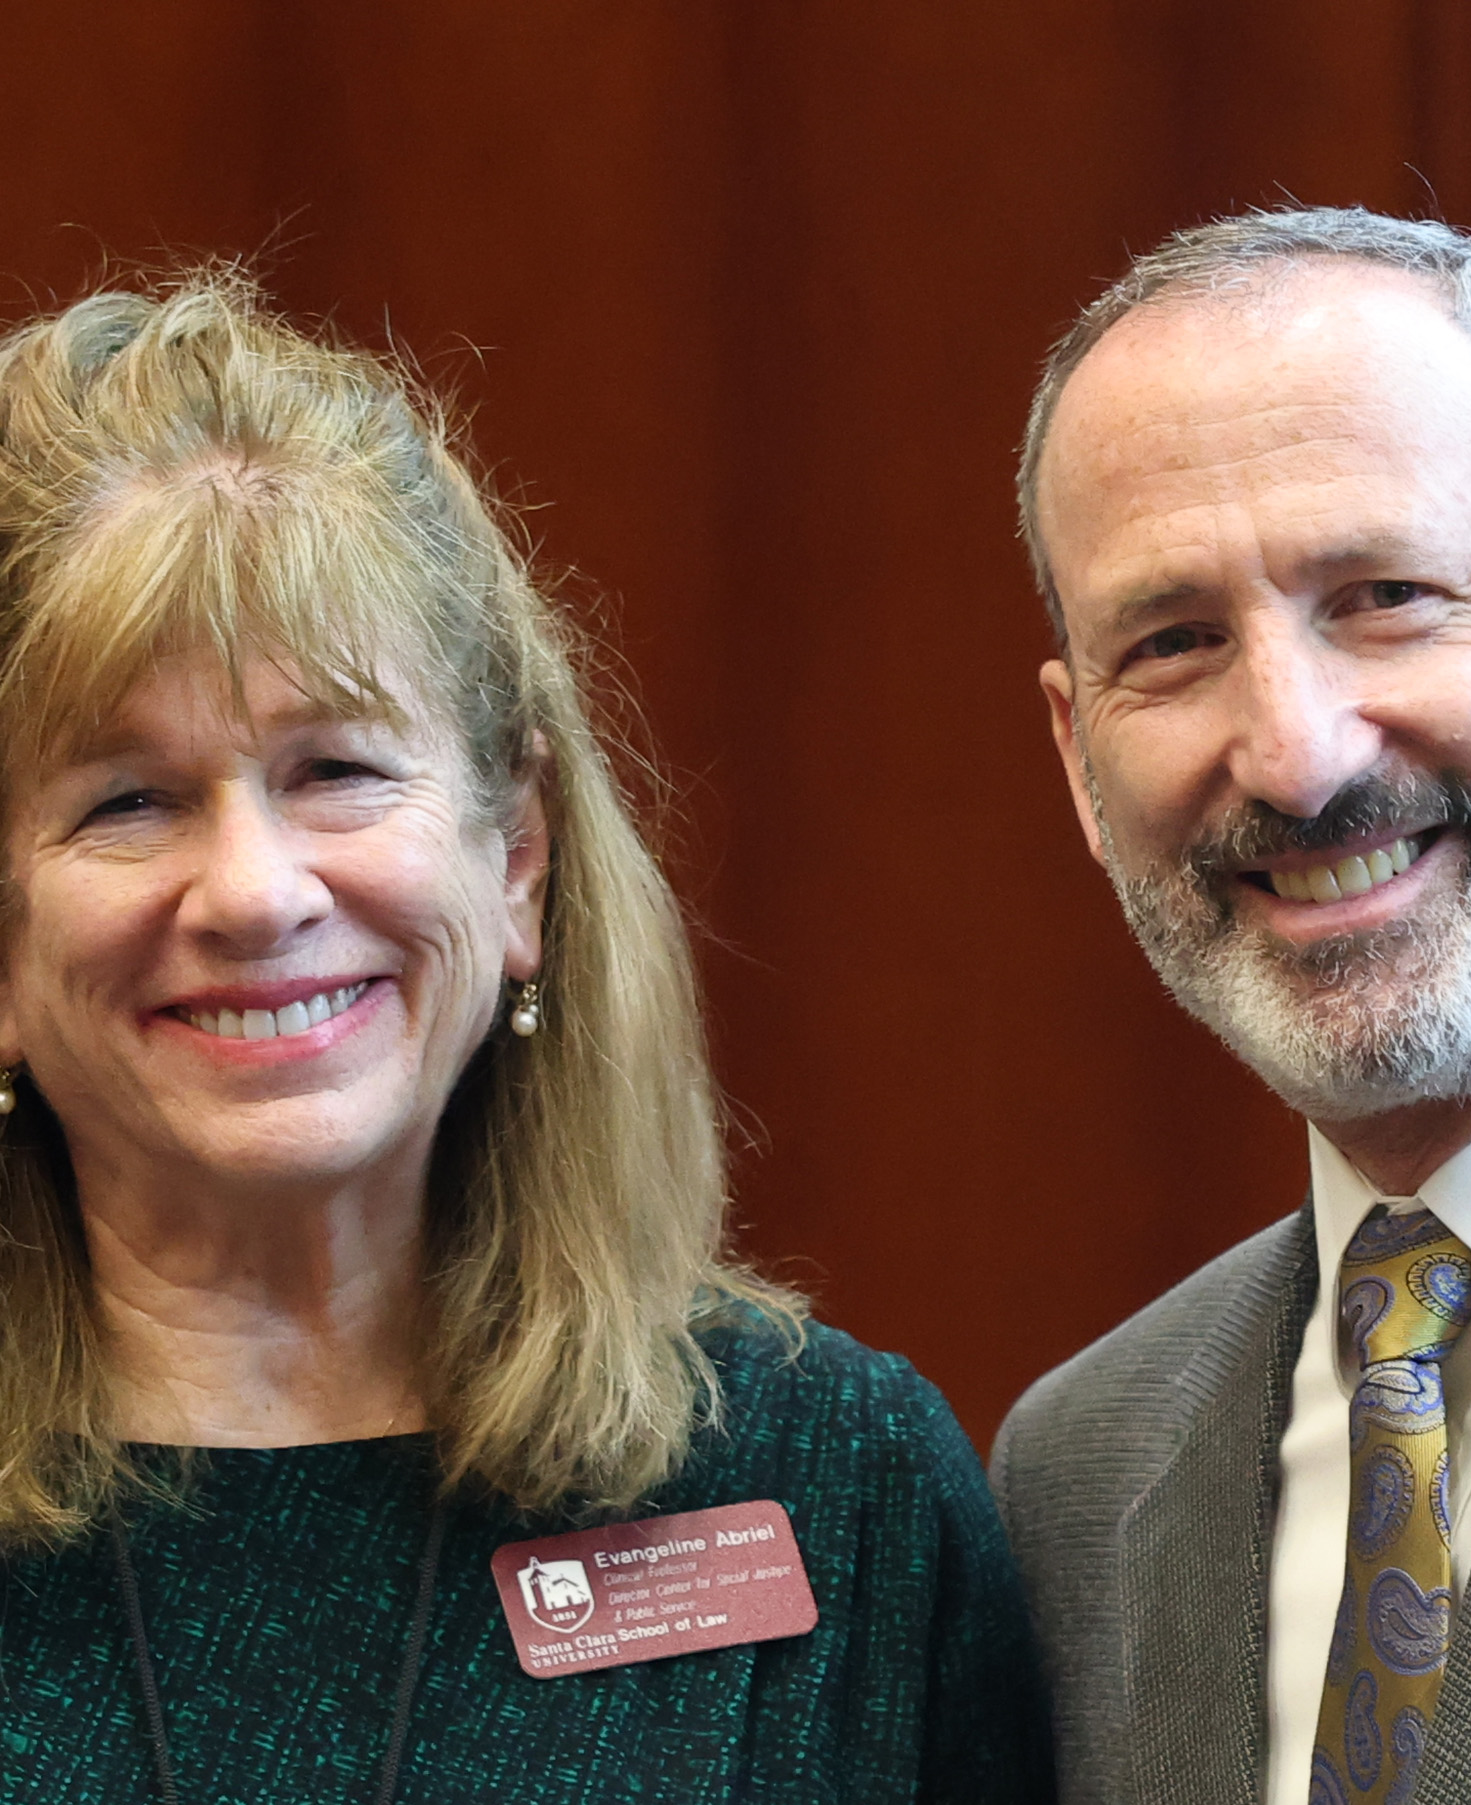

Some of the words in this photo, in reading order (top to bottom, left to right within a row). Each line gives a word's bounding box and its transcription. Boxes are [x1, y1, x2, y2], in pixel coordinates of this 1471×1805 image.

[593, 1537, 707, 1569] Evangeline
[715, 1524, 776, 1548] Abriel
[552, 1610, 577, 1623] 1851
[529, 1641, 573, 1658] Santa
[575, 1634, 617, 1649] Clara
[617, 1621, 669, 1642] School
[675, 1617, 692, 1632] of
[696, 1613, 728, 1629] Law
[530, 1645, 620, 1669] UNIVERSITY
